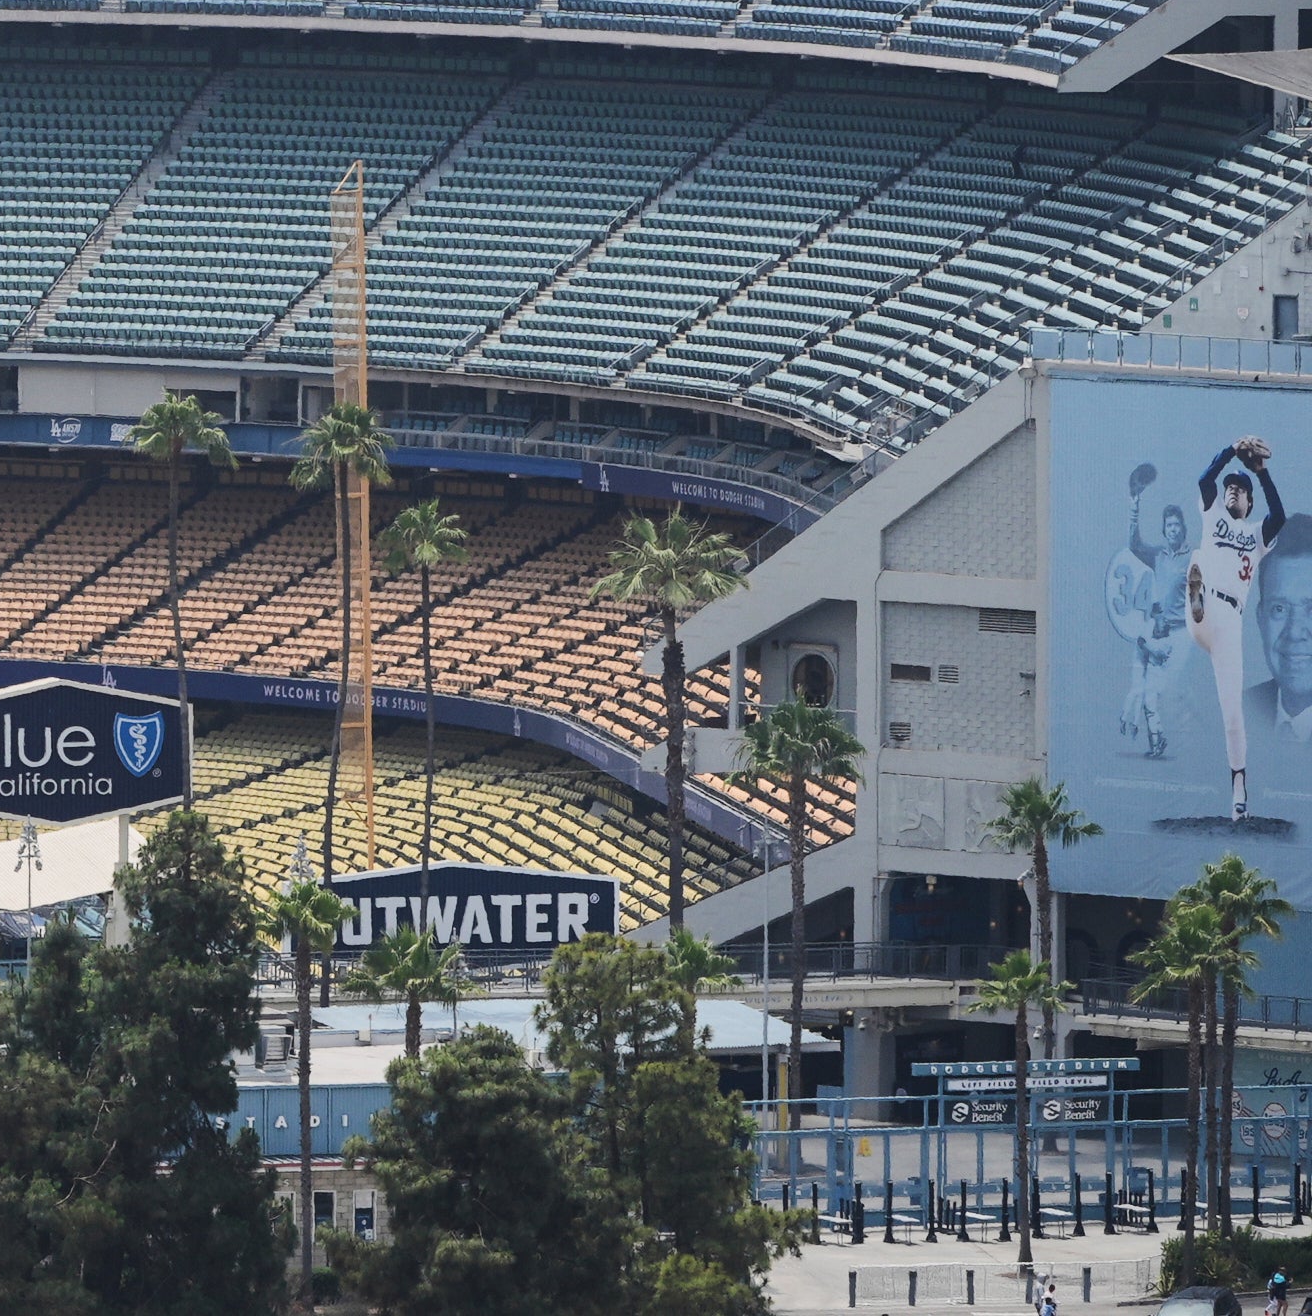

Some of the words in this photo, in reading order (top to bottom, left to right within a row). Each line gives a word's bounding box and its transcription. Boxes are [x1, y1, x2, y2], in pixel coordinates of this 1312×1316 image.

[671, 482, 707, 499] WELCOME
[709, 487, 718, 500] TO
[263, 684, 321, 703] WELCOME
[325, 691, 342, 703] TO
[330, 892, 590, 946] UTWATER
[930, 1064, 1016, 1075] DODGER
[1032, 1060, 1128, 1071] STADIUM
[971, 1100, 1008, 1114] Security
[1064, 1098, 1101, 1112] Security
[215, 1113, 375, 1130] STADI
[971, 1111, 1003, 1123] Benefit
[1064, 1110, 1096, 1120] Benefit
